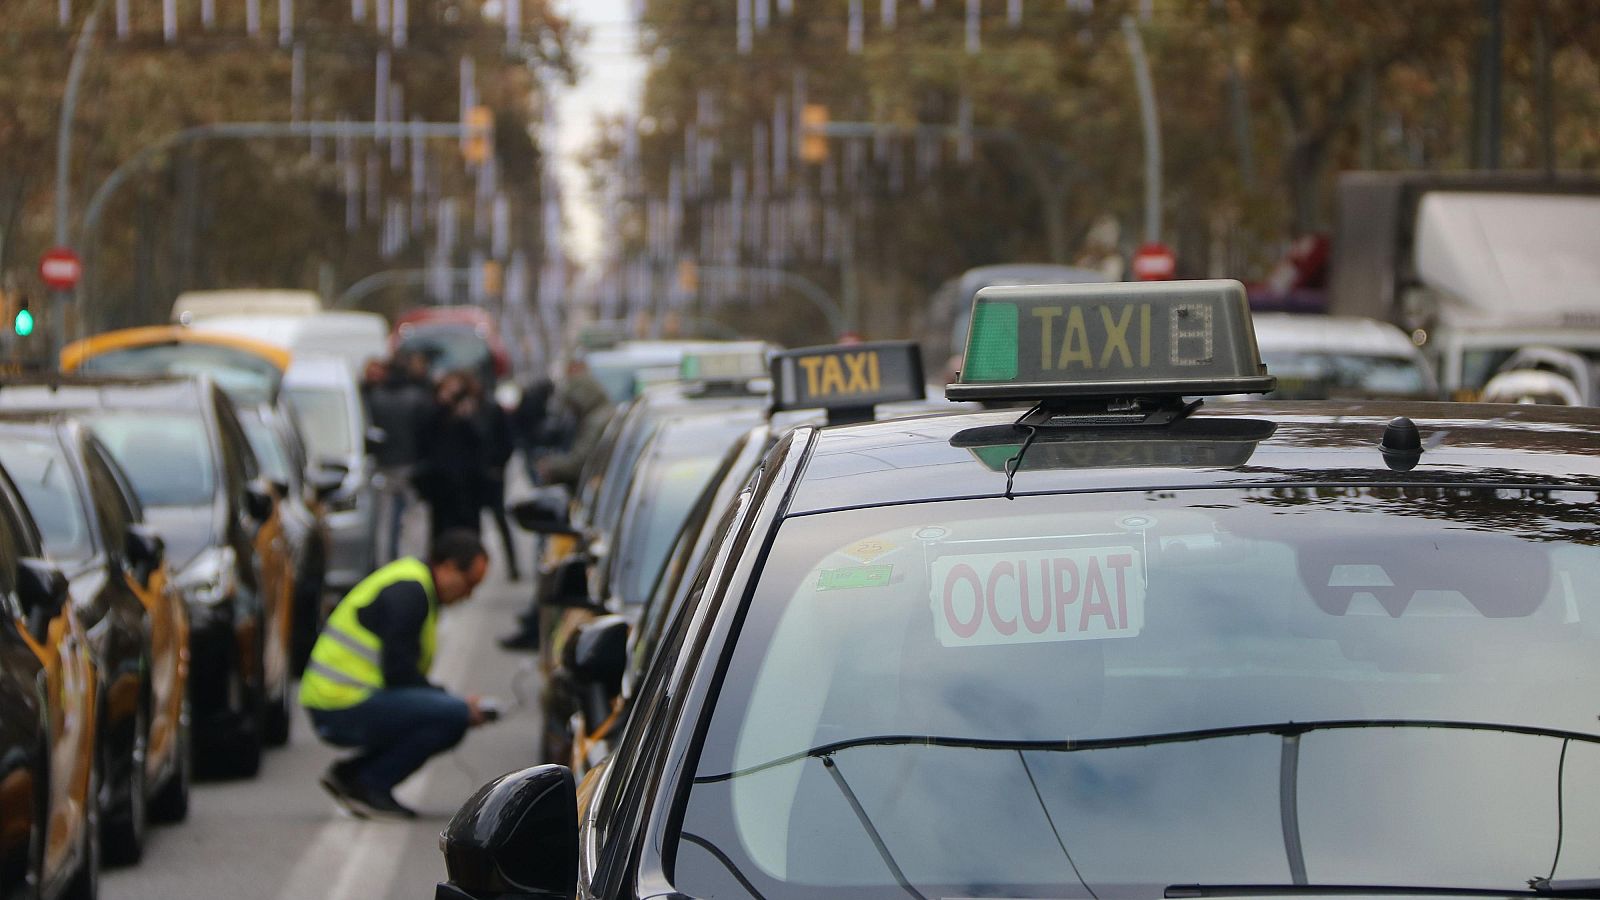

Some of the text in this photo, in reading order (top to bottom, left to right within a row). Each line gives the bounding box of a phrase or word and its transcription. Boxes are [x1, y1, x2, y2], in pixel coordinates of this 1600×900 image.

[1032, 304, 1151, 370] TAXI
[799, 351, 880, 397] TAXI
[943, 554, 1132, 638] OCUPAT
